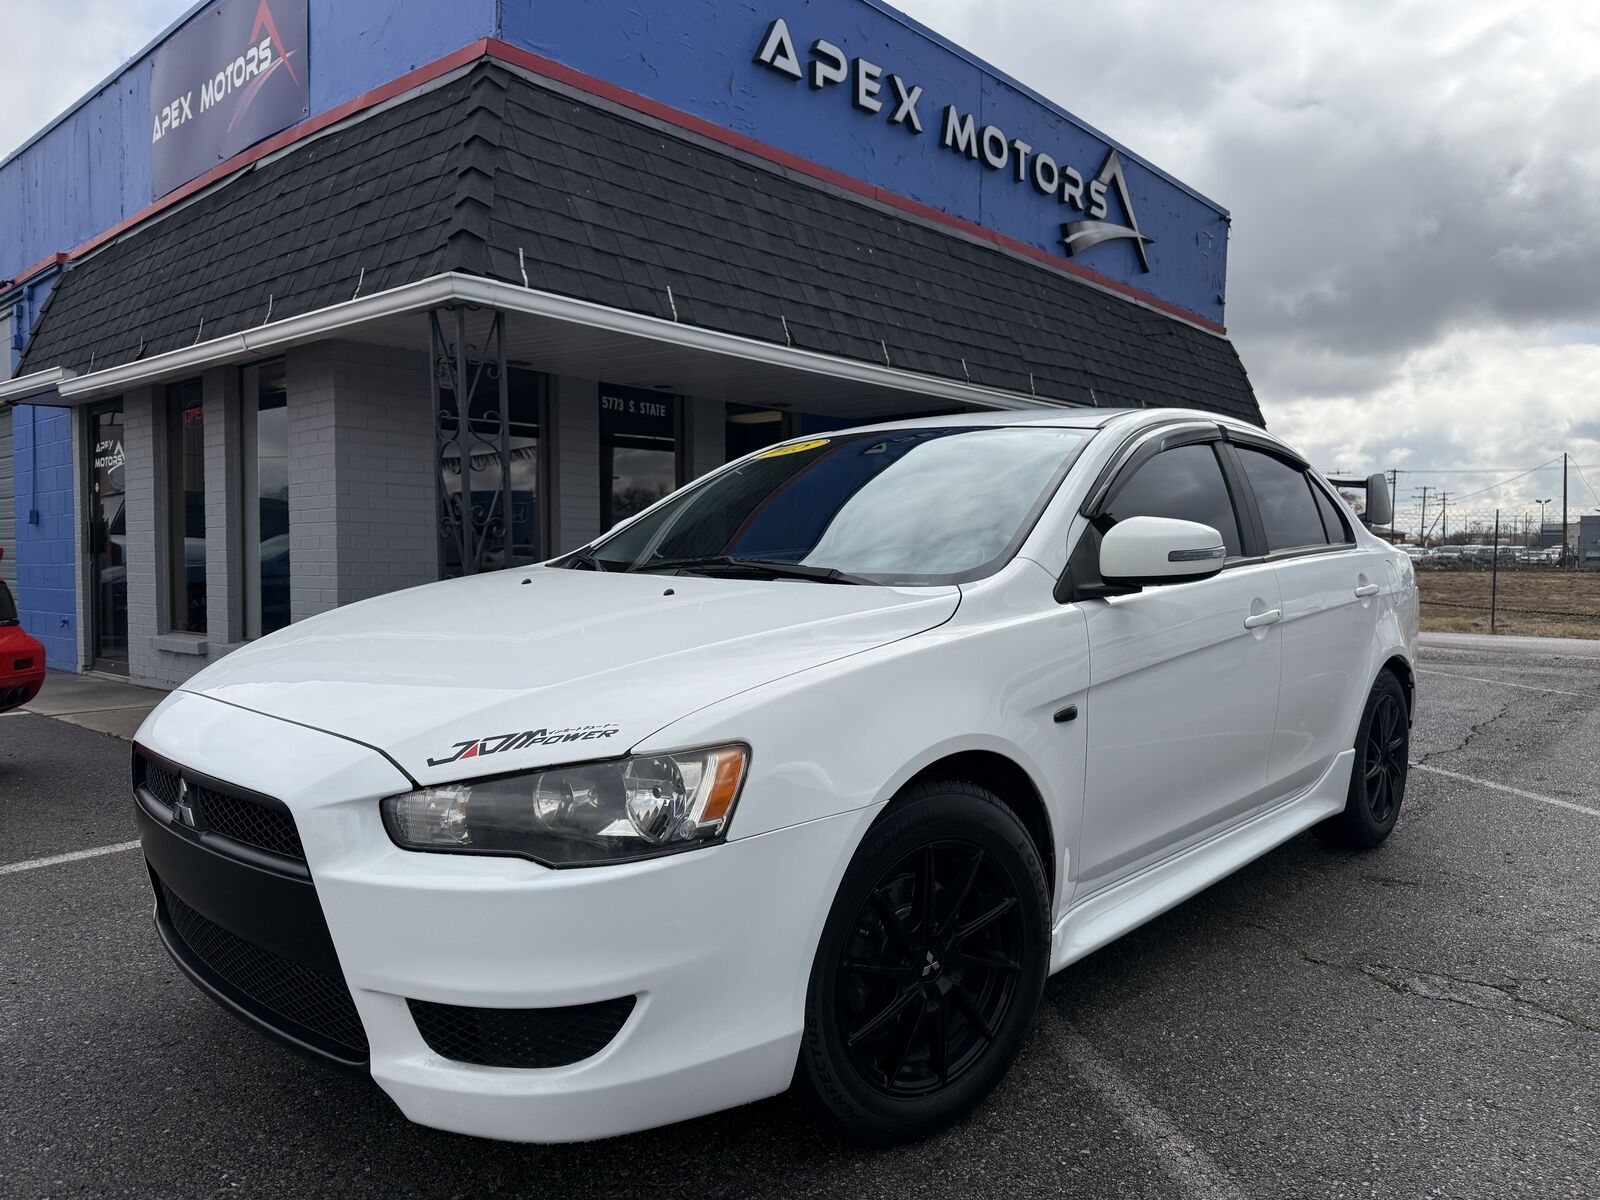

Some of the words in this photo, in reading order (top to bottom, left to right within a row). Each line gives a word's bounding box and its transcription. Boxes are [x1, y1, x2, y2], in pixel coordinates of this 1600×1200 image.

[152, 91, 193, 144] APEX
[200, 36, 272, 113] MOTORS
[754, 17, 923, 134] APEX
[940, 104, 1109, 220] MOTORS
[601, 396, 624, 412] 5773
[640, 402, 667, 417] STATE
[94, 454, 123, 469] MOTORS
[426, 728, 547, 767] JDM
[524, 729, 620, 748] POWER
